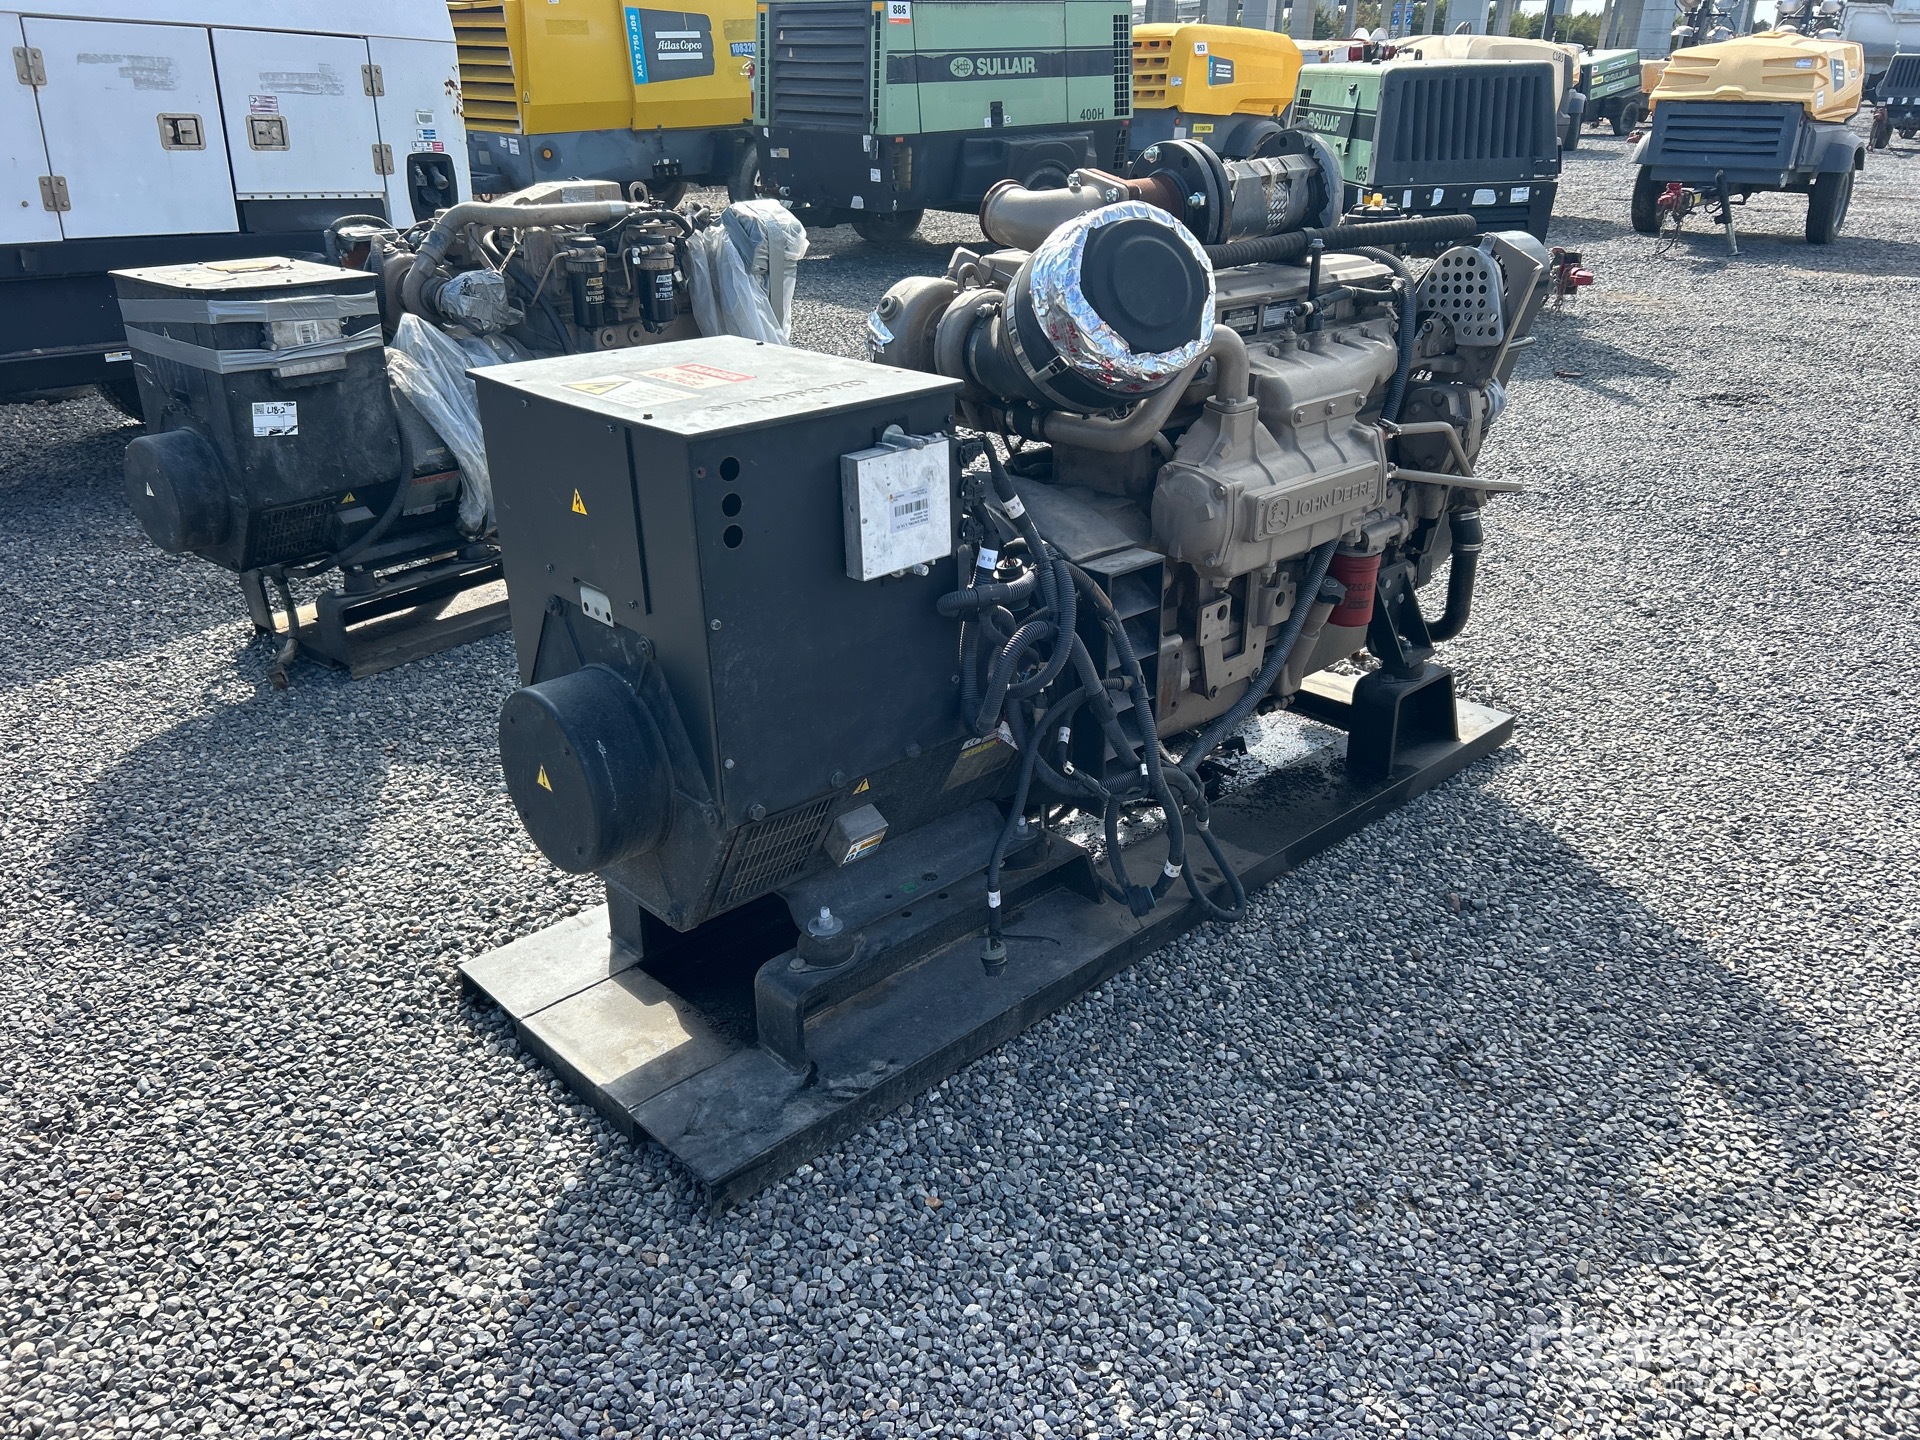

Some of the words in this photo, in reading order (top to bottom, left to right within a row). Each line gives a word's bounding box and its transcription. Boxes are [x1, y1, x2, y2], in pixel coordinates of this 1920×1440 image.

[892, 4, 906, 15] 886
[657, 40, 680, 51] Atlas
[680, 40, 702, 52] Copco
[1196, 44, 1206, 52] 953
[634, 53, 644, 77] XATS
[976, 57, 1036, 76] SULLAIR
[1080, 107, 1105, 122] 400H
[1355, 166, 1368, 182] 185
[1291, 493, 1331, 520] JOHN
[1331, 479, 1376, 506] DEERE
